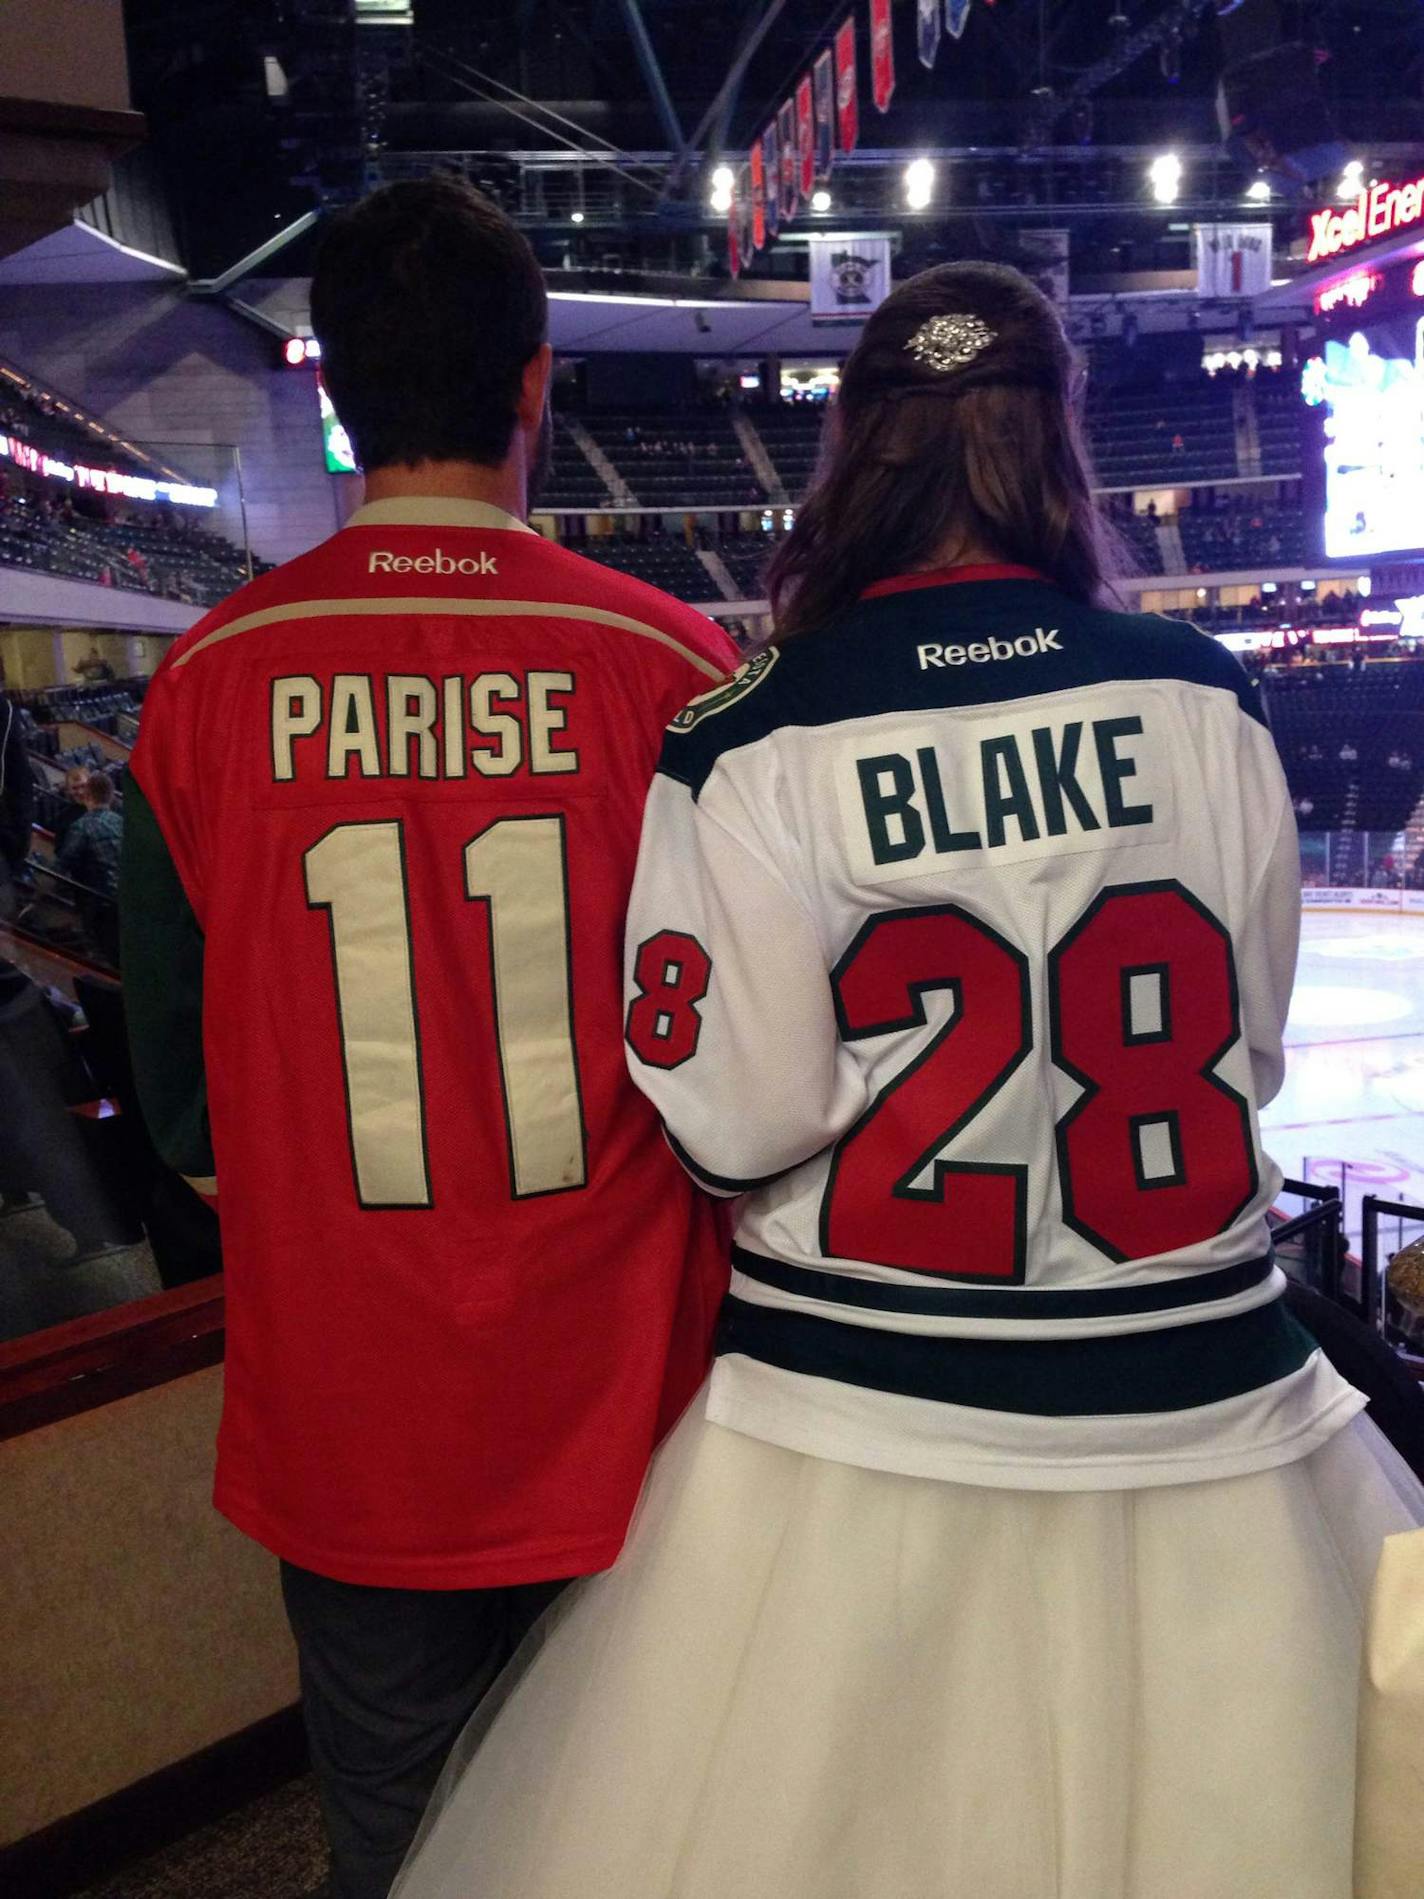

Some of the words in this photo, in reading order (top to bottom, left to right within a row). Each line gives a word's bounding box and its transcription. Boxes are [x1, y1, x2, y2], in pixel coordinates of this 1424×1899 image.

[1307, 187, 1367, 262] Xcel
[368, 548, 499, 575] Reebok
[916, 627, 1064, 671] Reebok
[270, 669, 580, 784] PARISE
[855, 715, 1154, 866] BLAKE
[303, 812, 589, 1211] 11
[624, 928, 713, 1071] 8
[818, 877, 1260, 1287] 28
